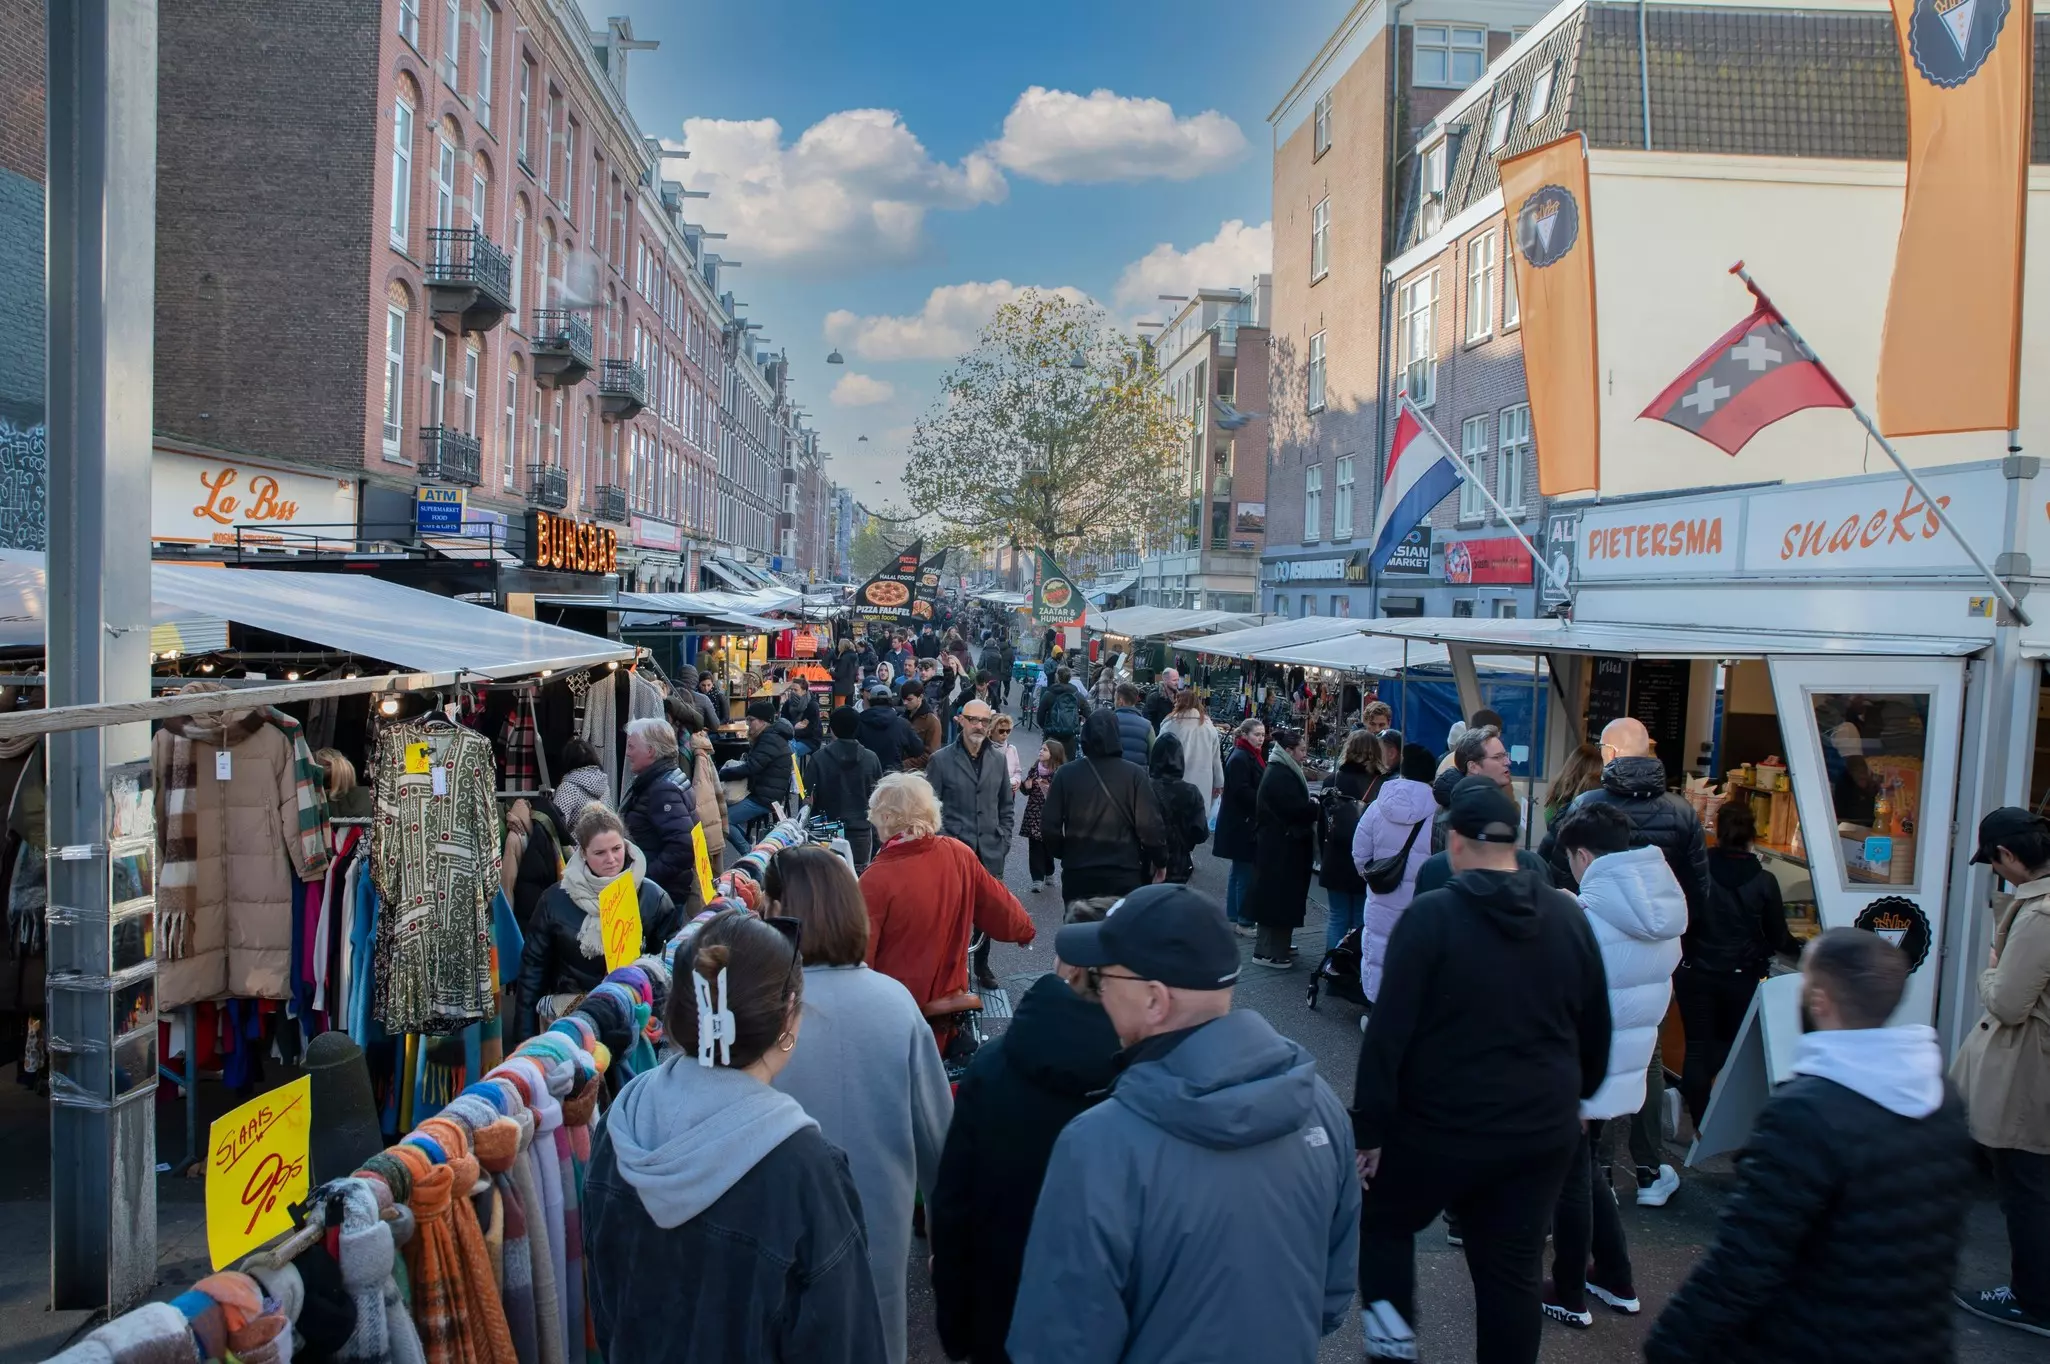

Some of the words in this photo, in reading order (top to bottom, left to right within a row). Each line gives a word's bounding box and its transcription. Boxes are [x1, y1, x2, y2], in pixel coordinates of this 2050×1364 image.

[193, 467, 241, 525] La
[425, 489, 456, 501] ATM
[420, 505, 460, 514] SUPERMARKET
[1780, 483, 1951, 561] snacks
[536, 511, 618, 573] BUNSBAR
[1588, 517, 1723, 560] PIETERSMA
[1386, 557, 1429, 568] MARKET
[897, 574, 916, 582] FOODS
[856, 605, 879, 614] PIZZA
[879, 606, 911, 617] FALAFEL
[1038, 607, 1068, 616] ZAATAR
[1040, 615, 1074, 624] HUMOUS
